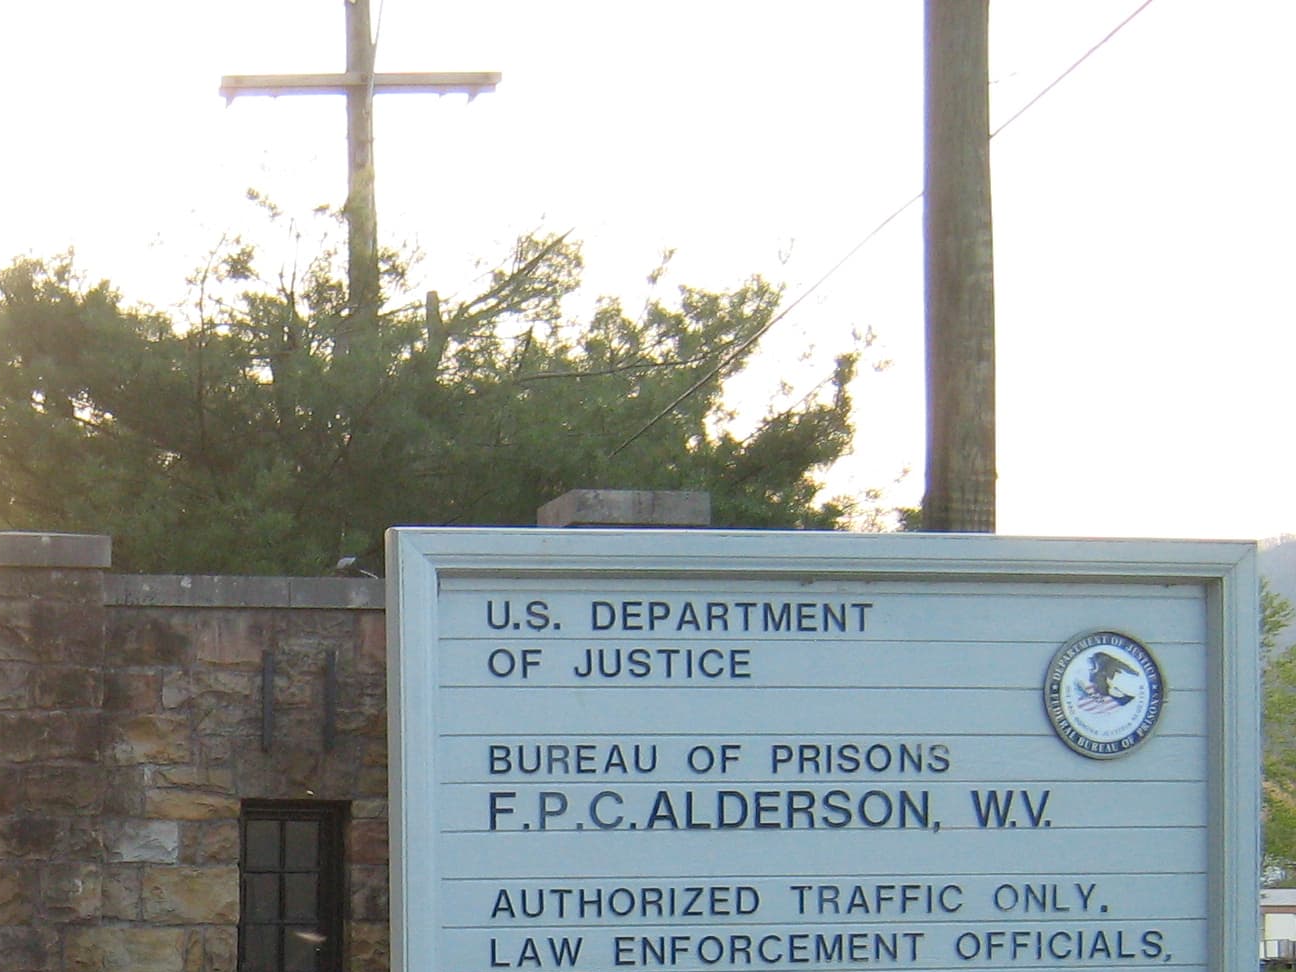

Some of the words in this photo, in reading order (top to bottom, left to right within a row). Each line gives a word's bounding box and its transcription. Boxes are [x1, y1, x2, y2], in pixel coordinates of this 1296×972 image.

[487, 601, 560, 632] U.S.
[592, 602, 872, 632] DEPARTMENT
[488, 650, 542, 679] OF
[574, 649, 751, 678] JUSTICE
[1053, 636, 1107, 681] DEPARTMENT
[1111, 636, 1123, 646] OF
[1127, 643, 1157, 679] JUSTICE
[1050, 693, 1079, 740] FEDERAL
[1077, 738, 1119, 753] BUREAU
[1121, 737, 1135, 749] OF
[489, 745, 656, 774] BUREAU
[687, 745, 741, 774] OF
[772, 744, 950, 774] PRISONS
[970, 790, 1052, 829] W.V.
[491, 887, 759, 918] AUTHORIZED
[790, 885, 962, 914] TRAFFIC
[994, 884, 1108, 912] ONLY.
[491, 937, 582, 968] LAW
[614, 933, 924, 966] ENFORCEMENT
[955, 931, 1171, 962] OFFICIALS,
